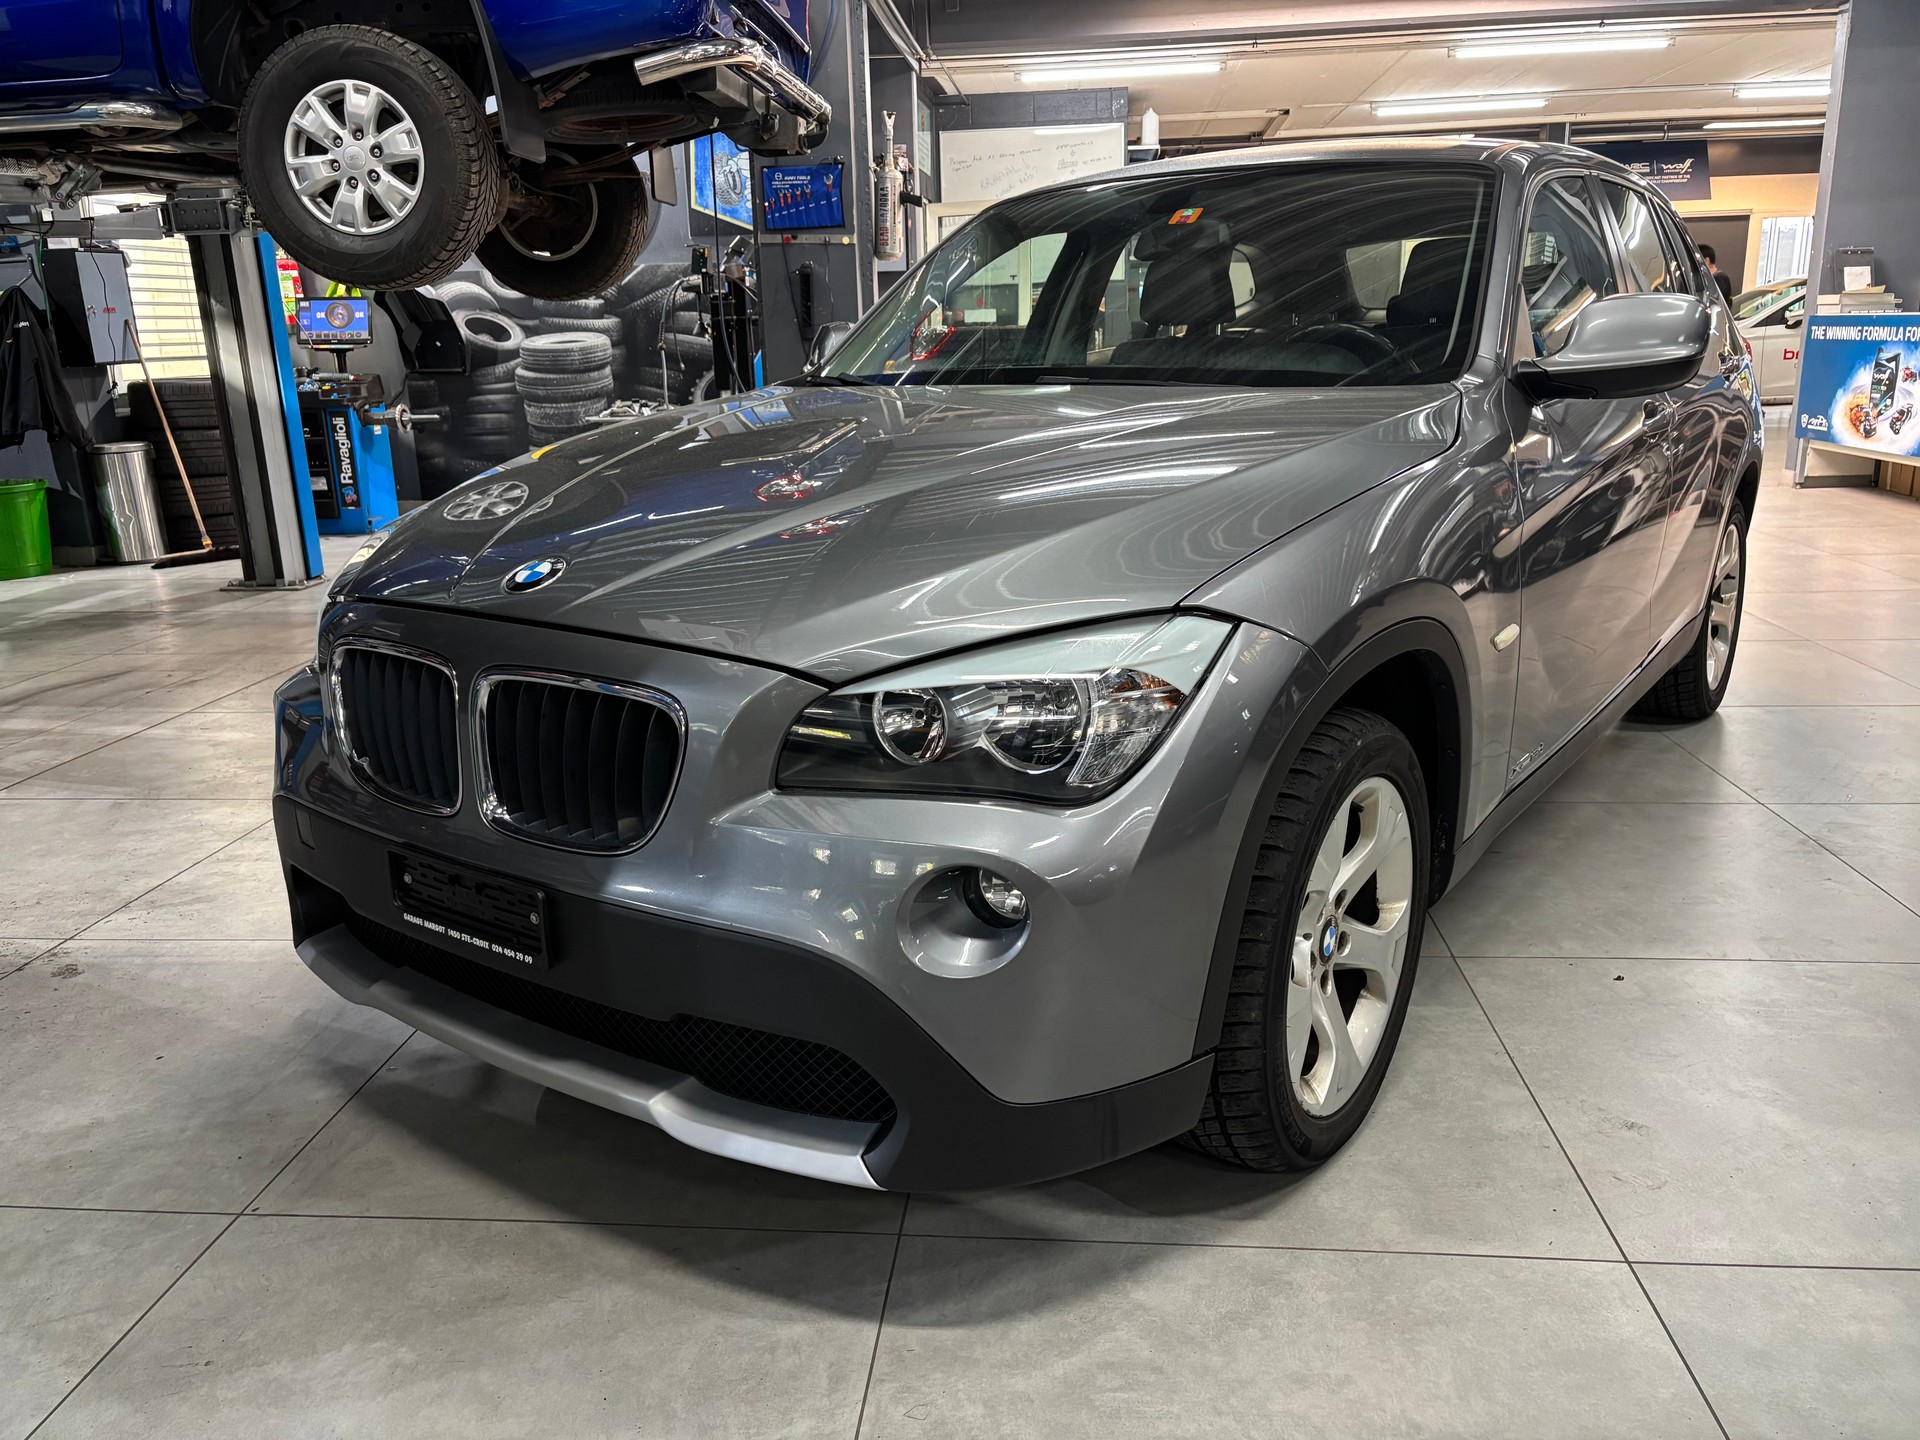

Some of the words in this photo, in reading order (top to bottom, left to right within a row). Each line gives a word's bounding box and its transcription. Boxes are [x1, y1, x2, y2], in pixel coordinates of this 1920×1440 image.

[879, 186, 889, 224] BAZOOKA
[316, 311, 326, 319] OK
[1811, 325, 1826, 340] THE
[1826, 326, 1861, 341] WINNING
[1862, 326, 1903, 342] FORMULA
[332, 417, 354, 484] Ravaglioli
[404, 912, 424, 926] GARAGE
[424, 919, 446, 935] MARGOT
[447, 928, 461, 940] 1450
[461, 933, 490, 950] STE-CROIX
[491, 943, 503, 955] 024
[503, 947, 515, 959] 454
[516, 951, 524, 962] 29
[524, 955, 533, 965] 09
